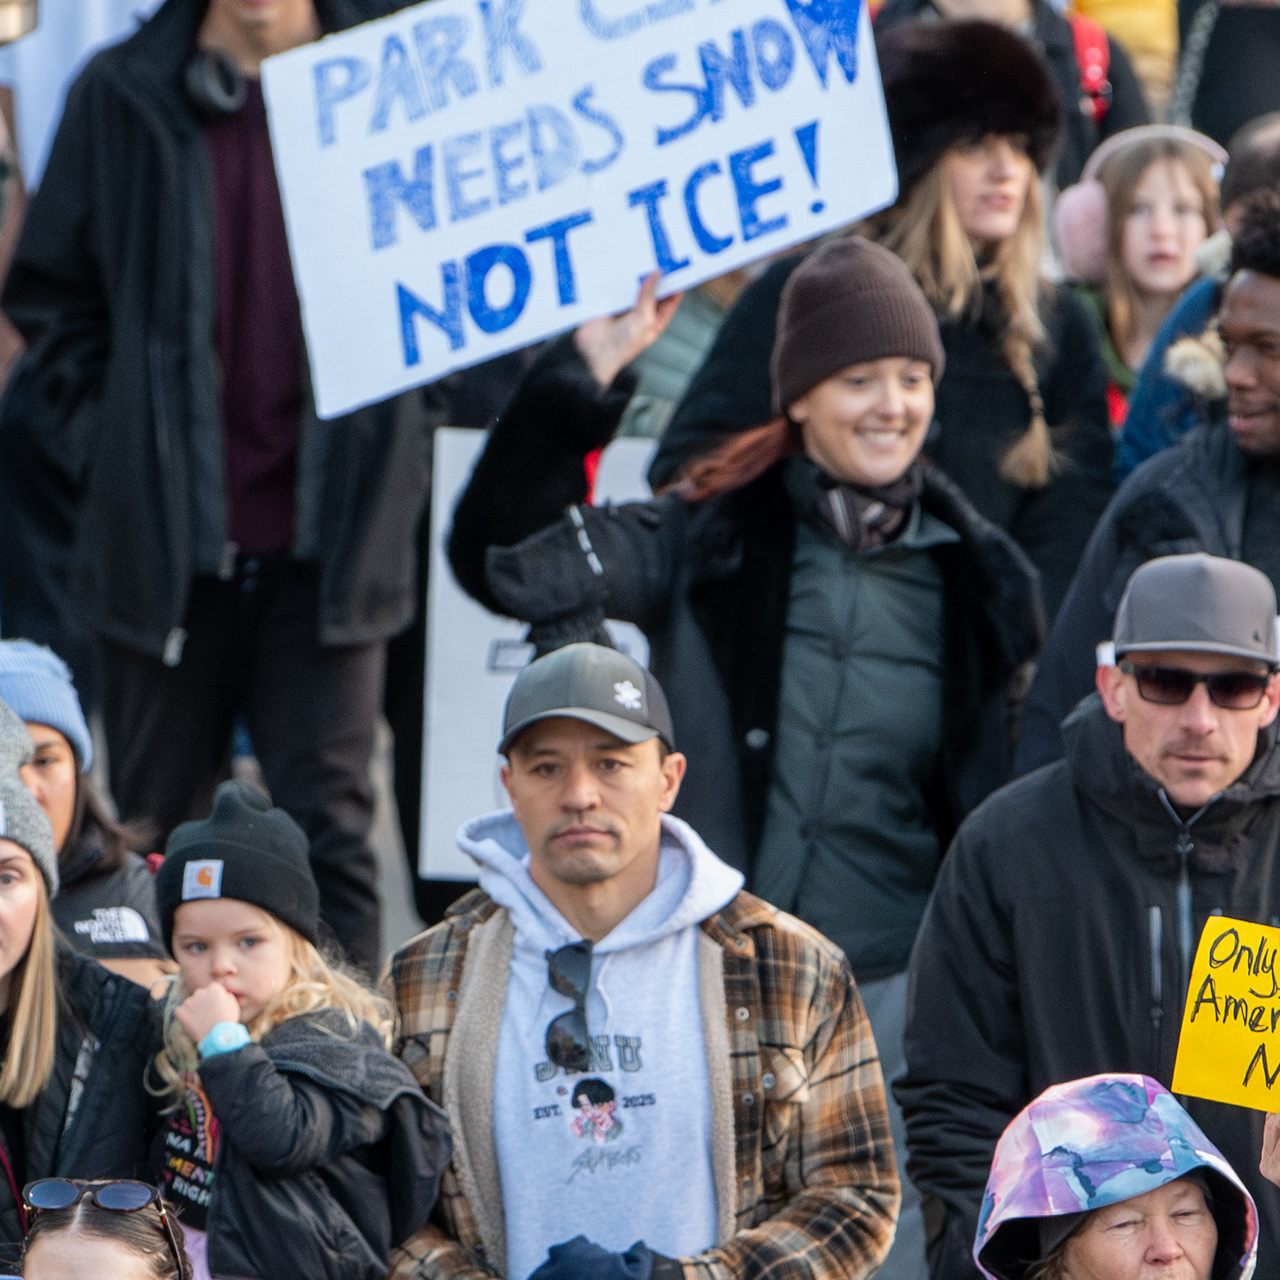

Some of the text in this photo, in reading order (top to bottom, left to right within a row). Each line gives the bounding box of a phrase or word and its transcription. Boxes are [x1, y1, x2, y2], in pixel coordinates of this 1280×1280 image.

[311, 0, 543, 148] PARK
[361, 0, 863, 252] NEEDS SNOW
[395, 119, 826, 368] NOT ICE!
[1209, 928, 1278, 998] Only
[172, 1175, 212, 1207] RIGH
